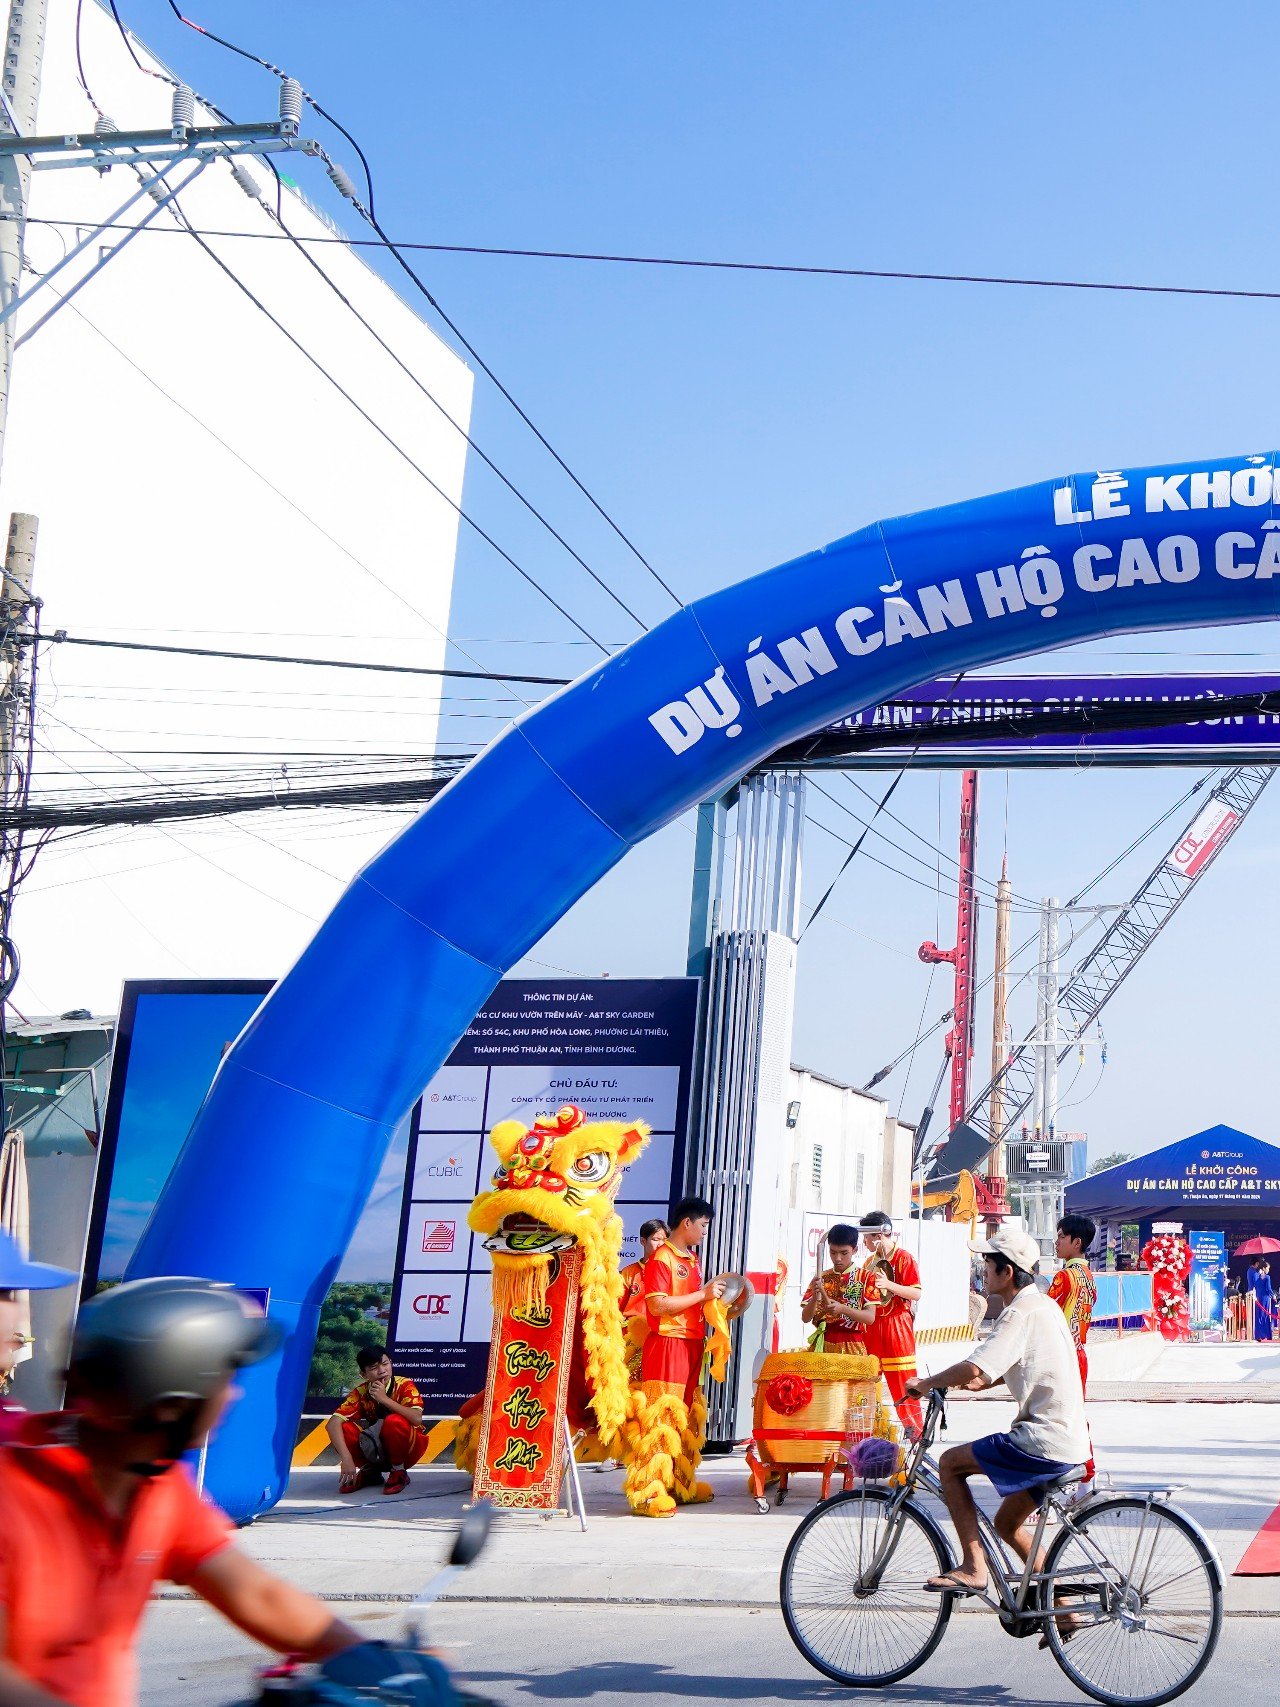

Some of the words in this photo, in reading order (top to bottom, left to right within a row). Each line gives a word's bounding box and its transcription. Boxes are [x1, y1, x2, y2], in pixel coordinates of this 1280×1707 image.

[1052, 470, 1132, 526] LỄ
[646, 665, 743, 756] DỰ
[743, 636, 838, 709] ÁN
[834, 579, 972, 660] CĂN
[978, 544, 1065, 620] HỘ
[1074, 530, 1201, 594] CAO
[523, 992, 550, 1001] THÔNG
[566, 992, 578, 1003] DỰ
[579, 992, 594, 1001] ÁN:
[520, 1011, 543, 1019] VƯỜN
[544, 1011, 565, 1019] TRÊN
[550, 1028, 568, 1036] HÒA
[550, 1078, 573, 1088] CHỦ
[602, 1079, 618, 1088] TƯ:
[428, 1166, 464, 1177] CUBIC
[1226, 1165, 1258, 1176] CÔNG
[1143, 1178, 1156, 1190] ÁN
[1196, 1180, 1217, 1190] CAO
[1240, 1180, 1262, 1190] A&T
